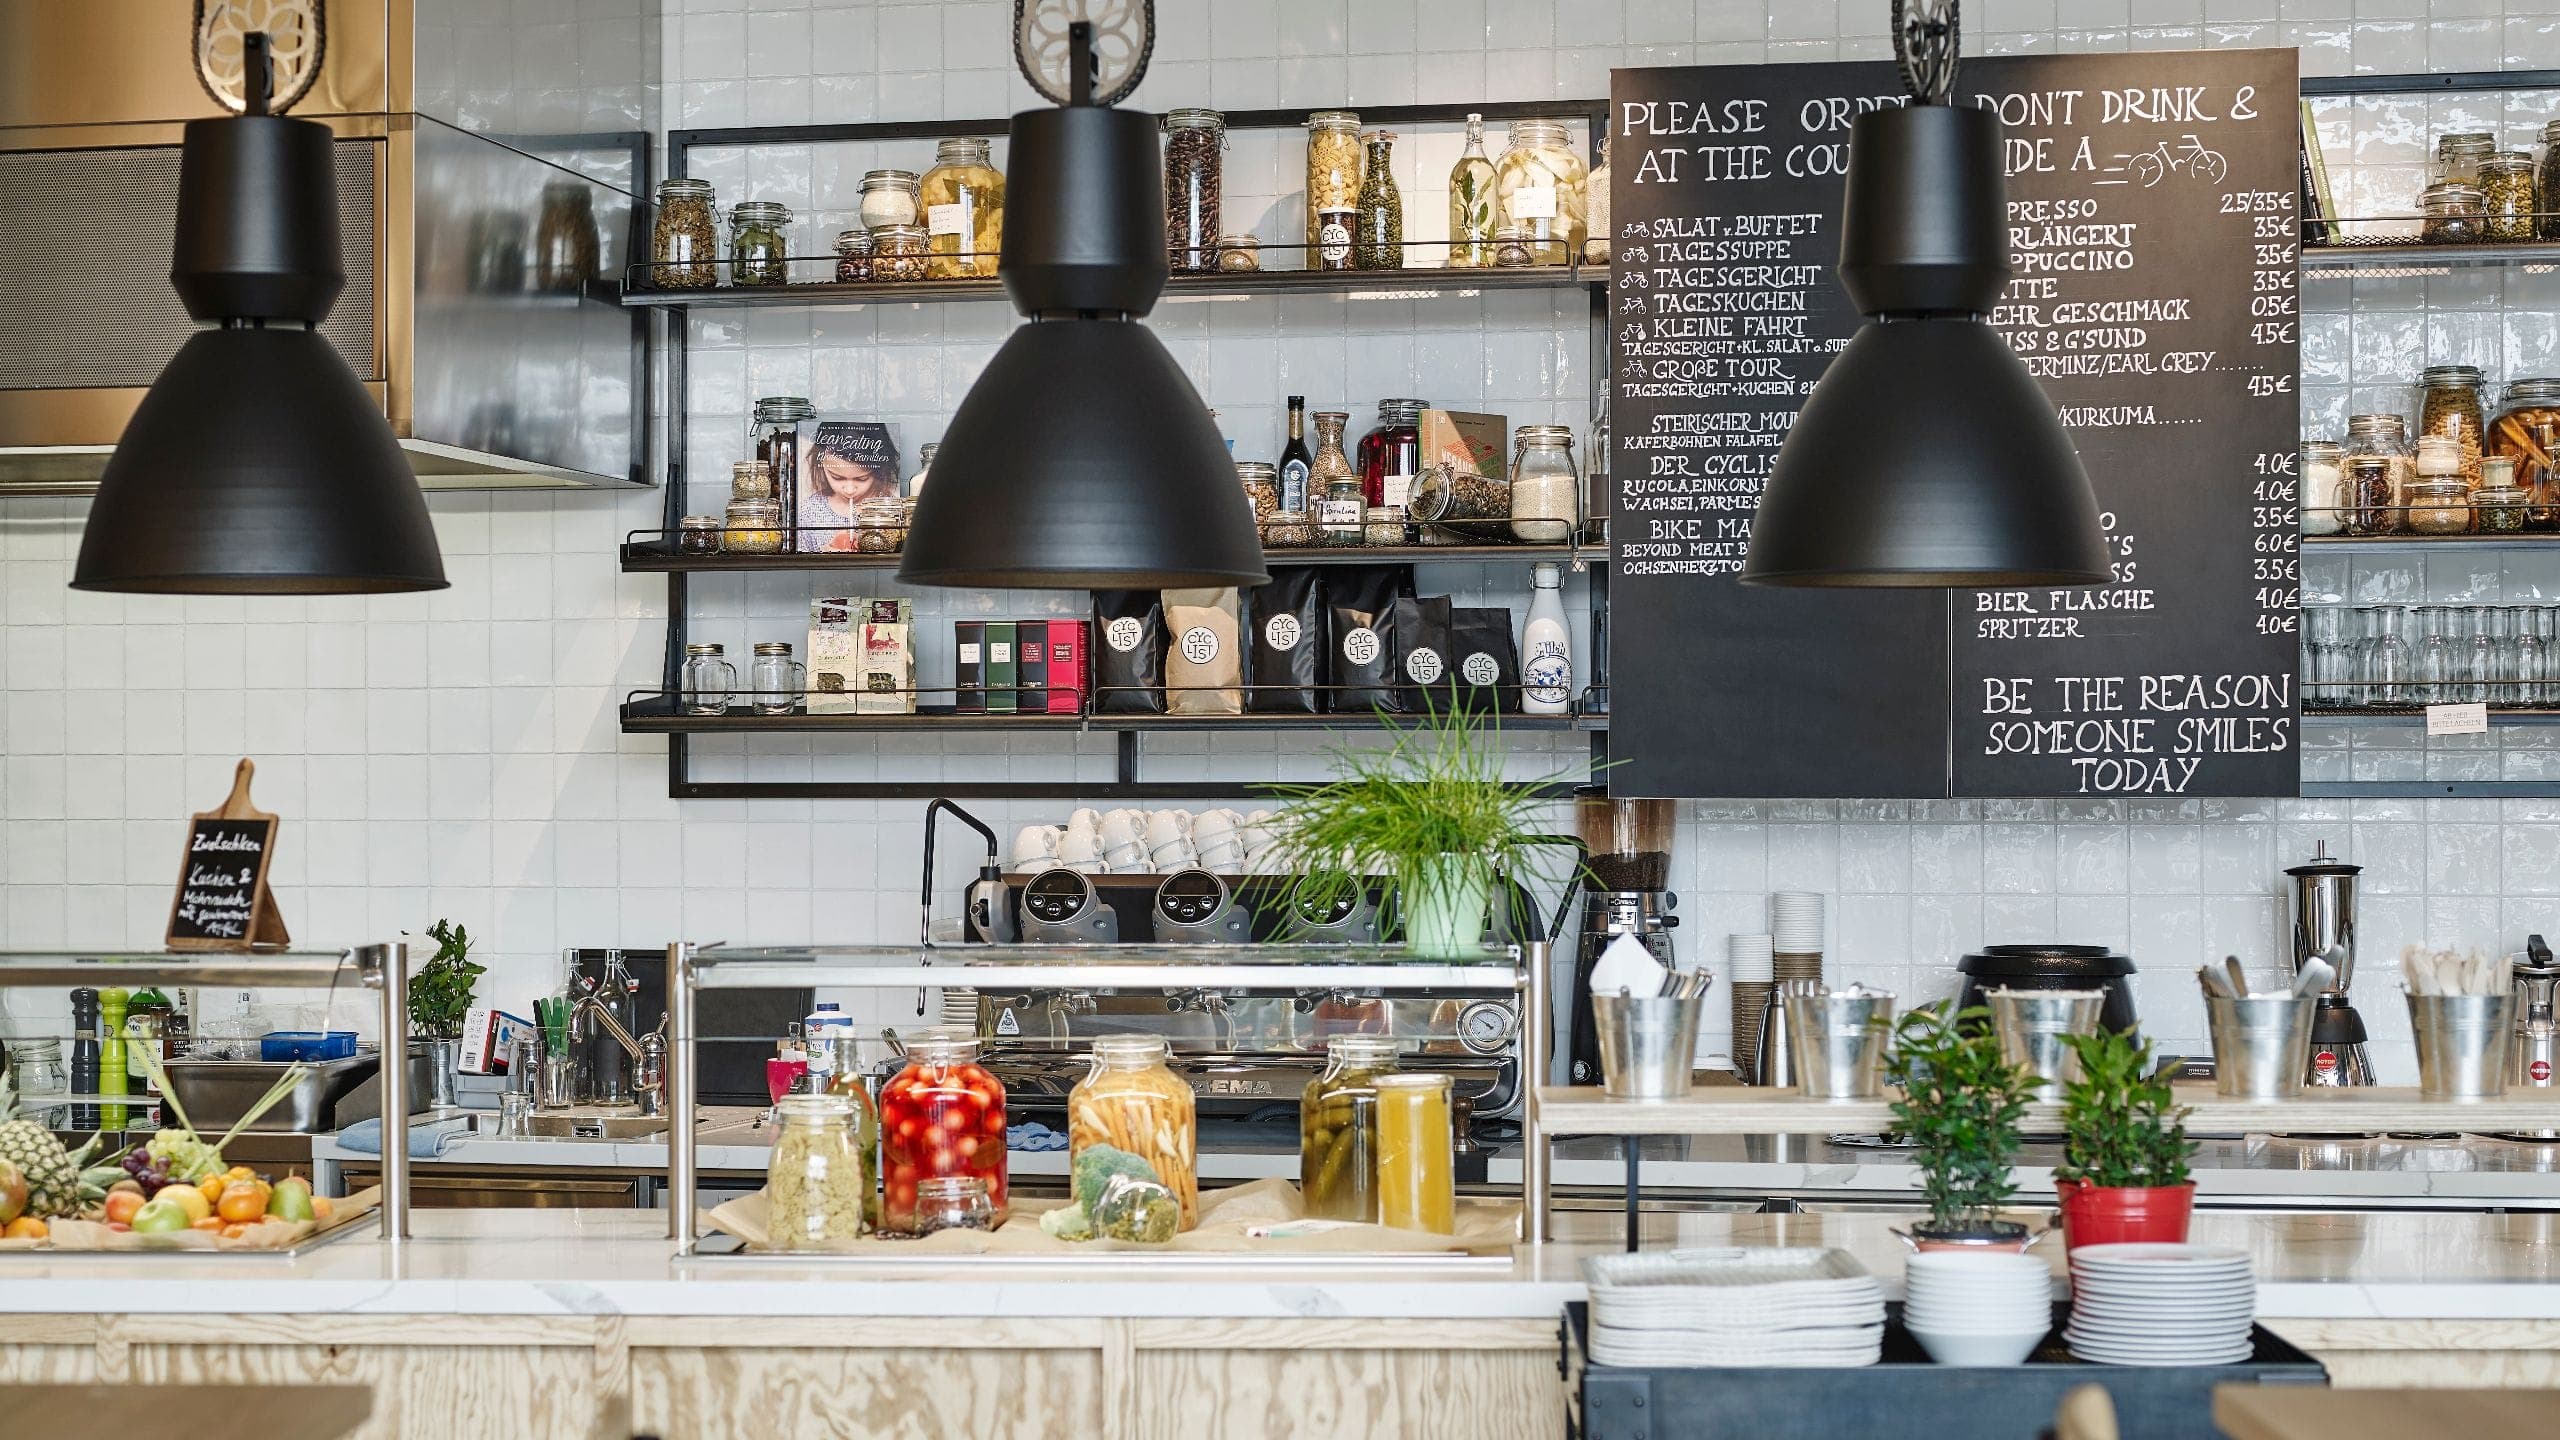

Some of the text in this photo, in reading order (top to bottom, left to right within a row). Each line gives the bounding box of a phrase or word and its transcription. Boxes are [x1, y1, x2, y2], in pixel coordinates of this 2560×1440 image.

[2101, 86, 2217, 123] DRINK
[2230, 85, 2258, 120] &
[1622, 100, 1767, 136] PLEASE
[1634, 144, 1850, 183] AT THE COU
[2004, 136, 2096, 177] IDE A
[2007, 198, 2098, 222] PRESSO
[1652, 217, 1721, 239] SALAT
[2009, 221, 2137, 249] RLÄNGERT
[1654, 240, 1791, 263] TAGESSUPPE
[2010, 250, 2134, 273] PPUCCINO
[1654, 265, 1822, 289] TAGESGERICHT
[2000, 277, 2058, 299] TTE
[1654, 290, 1806, 313] TAGESKUCHEN
[2053, 299, 2190, 324] GESCHMACK
[1653, 315, 1808, 338] KLEINE FAHRT
[1767, 338, 1813, 354] SALAT
[1825, 338, 1853, 353] SUP
[2046, 330, 2061, 352] &
[2064, 328, 2147, 350] G'SUND
[1725, 357, 1796, 380] TOUR
[1652, 412, 1761, 434] STEIRISCHER
[1726, 433, 1783, 447] FALAFEL
[1651, 454, 1779, 476] DER CYCLIS
[2253, 452, 2298, 476] 4.0€
[2253, 480, 2297, 501] 4.0€
[2253, 506, 2299, 528] 3.5€
[1650, 518, 1752, 540] BIKE MA
[1622, 541, 1750, 558] BEYOND MEAT B
[2254, 533, 2298, 553] 6.0€
[1623, 560, 1747, 577] OCHSENHERZTO
[2254, 558, 2298, 580] 3.5€
[1976, 589, 2155, 614] BIER FLASCHE
[1112, 620, 1136, 633] CYC
[1271, 618, 1295, 631] CYC
[1977, 617, 2085, 639] SPRITZER
[1112, 632, 1138, 647] LIST
[1188, 631, 1212, 644] CYC
[1271, 630, 1297, 646] LIST
[1349, 632, 1373, 646] CYC
[1187, 644, 1214, 660] LIST
[1349, 645, 1376, 660] LIST
[1411, 651, 1436, 665] CYC
[1468, 656, 1493, 670] CYC
[1412, 665, 1438, 680] LIST
[1468, 669, 1496, 683] LIST
[1982, 673, 2291, 715] BE THE REASON
[1985, 717, 2290, 756] SOMEONE SMILES
[2071, 757, 2202, 794] TODAY
[1191, 1079, 1272, 1095] AEMA
